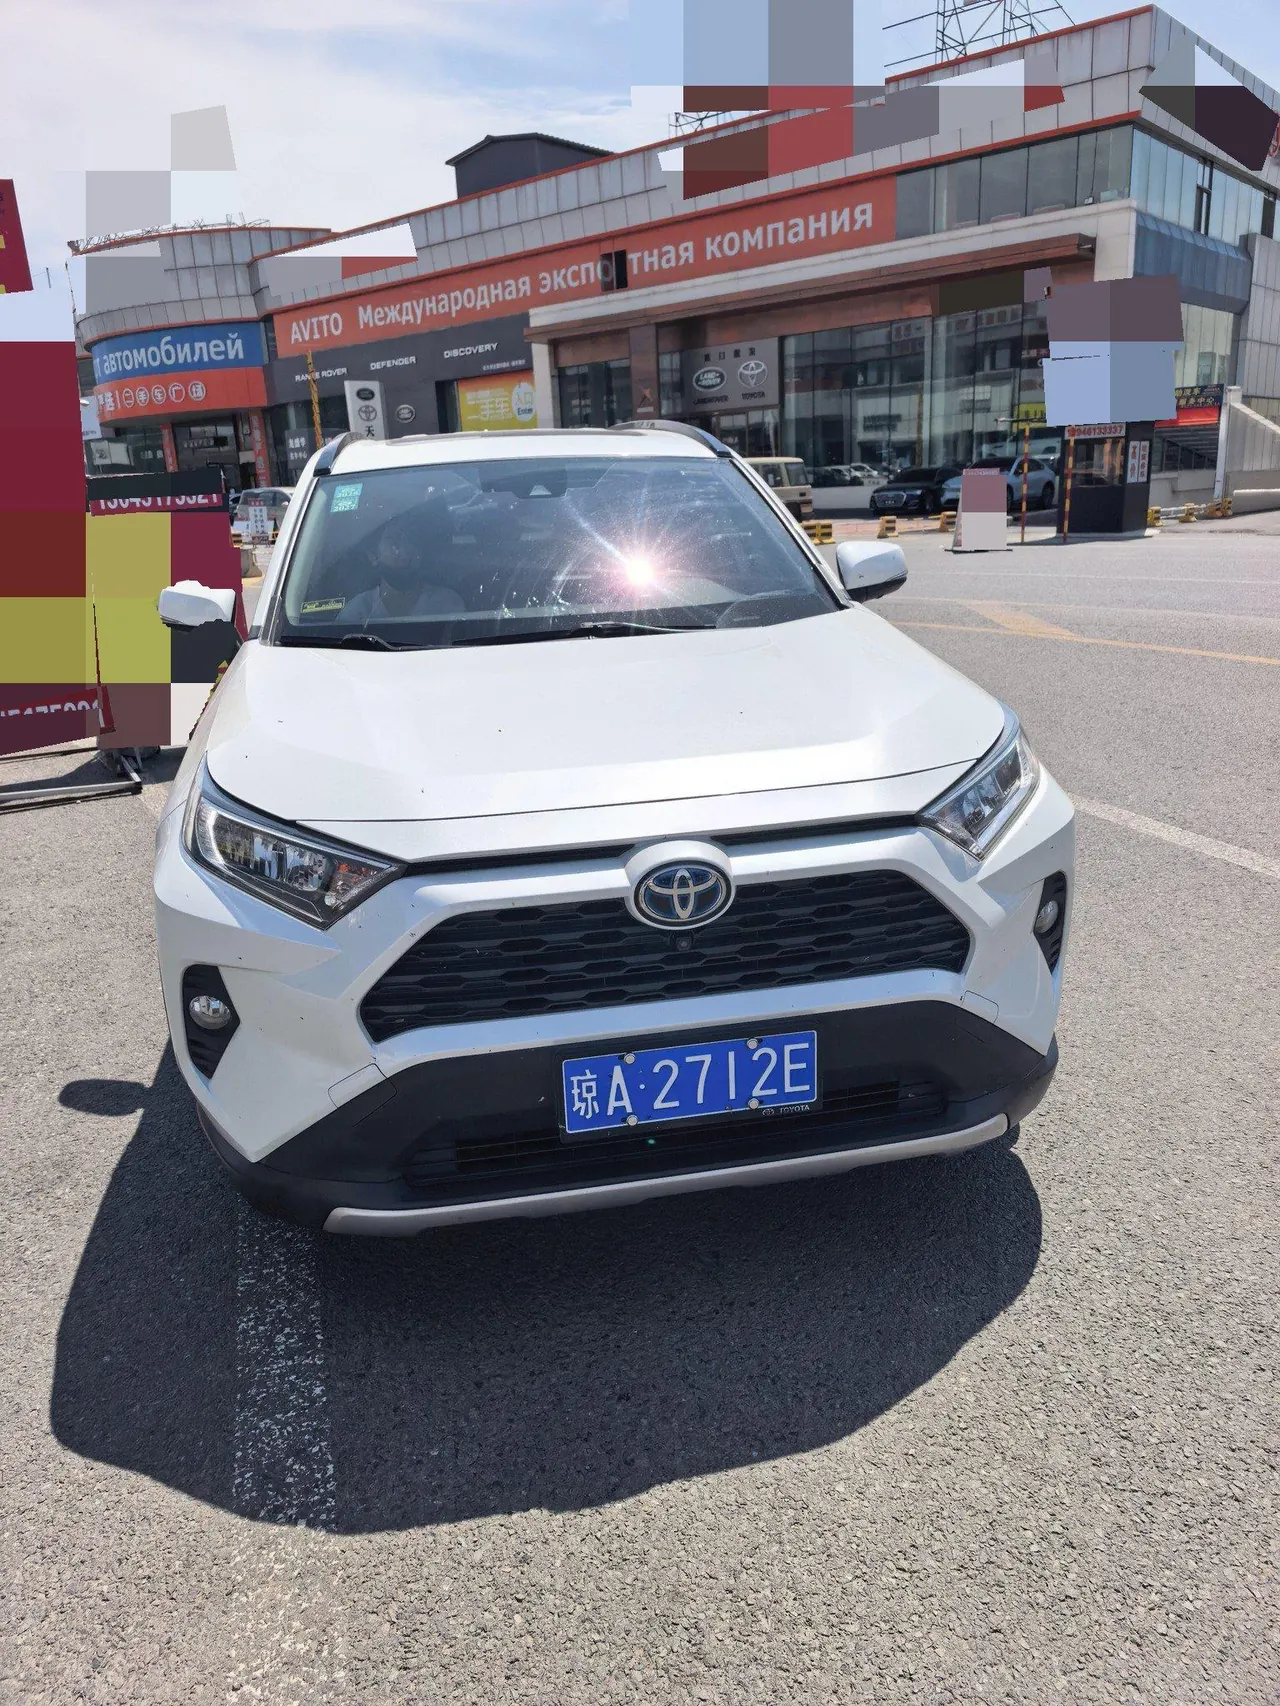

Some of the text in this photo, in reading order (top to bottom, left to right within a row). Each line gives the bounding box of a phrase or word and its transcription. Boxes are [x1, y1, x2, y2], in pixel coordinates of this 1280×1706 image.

[290, 202, 873, 344] AVITO Международная экспотная компания
[103, 332, 244, 375] автомобилей
[443, 342, 498, 359] DISCOVERY
[370, 356, 416, 370] DEFENDER
[780, 1104, 810, 1114] TOYOTA
